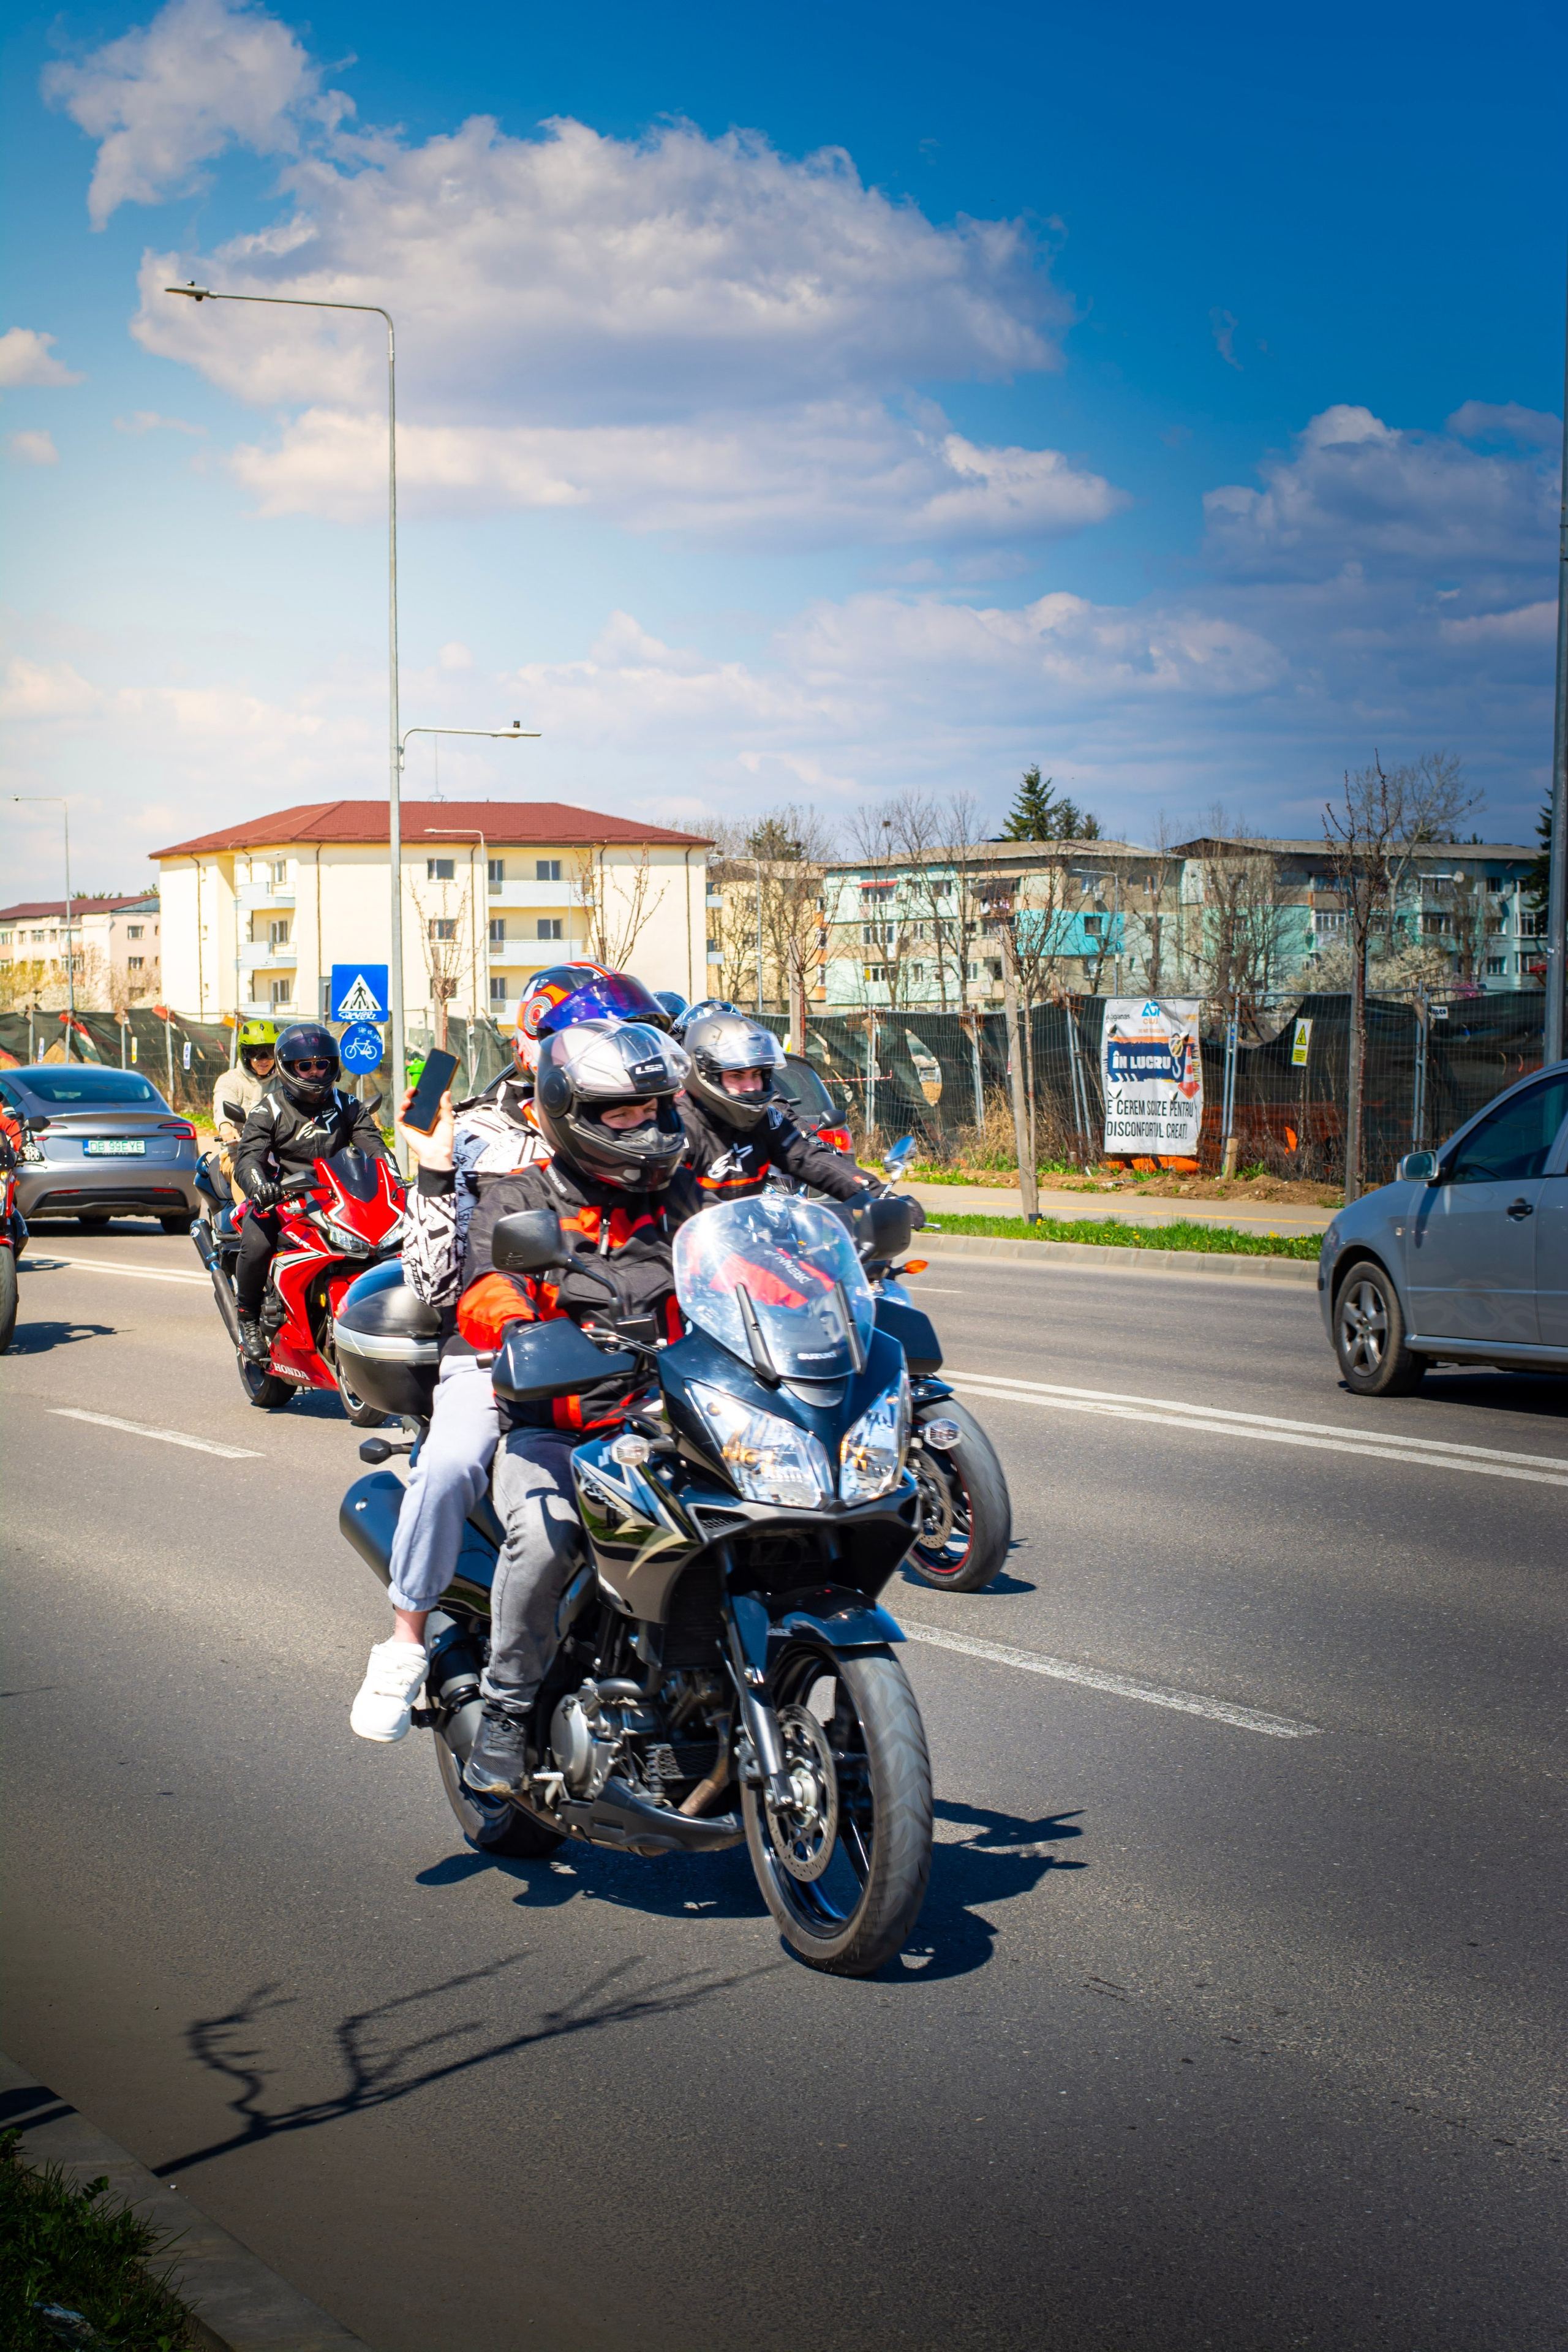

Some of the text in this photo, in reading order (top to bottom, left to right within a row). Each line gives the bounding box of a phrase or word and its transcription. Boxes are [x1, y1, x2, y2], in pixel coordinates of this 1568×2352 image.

[1112, 1050, 1171, 1069] ÎN LUCRU
[635, 1064, 664, 1074] LS2
[1117, 1100, 1145, 1115] CEREM
[1147, 1101, 1167, 1116] SCUZE
[1169, 1101, 1194, 1117] PENTRU
[1107, 1121, 1188, 1140] DISCONFORTUL CREAT!
[90, 1142, 105, 1152] DB
[285, 1231, 311, 1249] CBR
[797, 1351, 837, 1360] SUZUKI
[273, 1362, 311, 1381] HONDA
